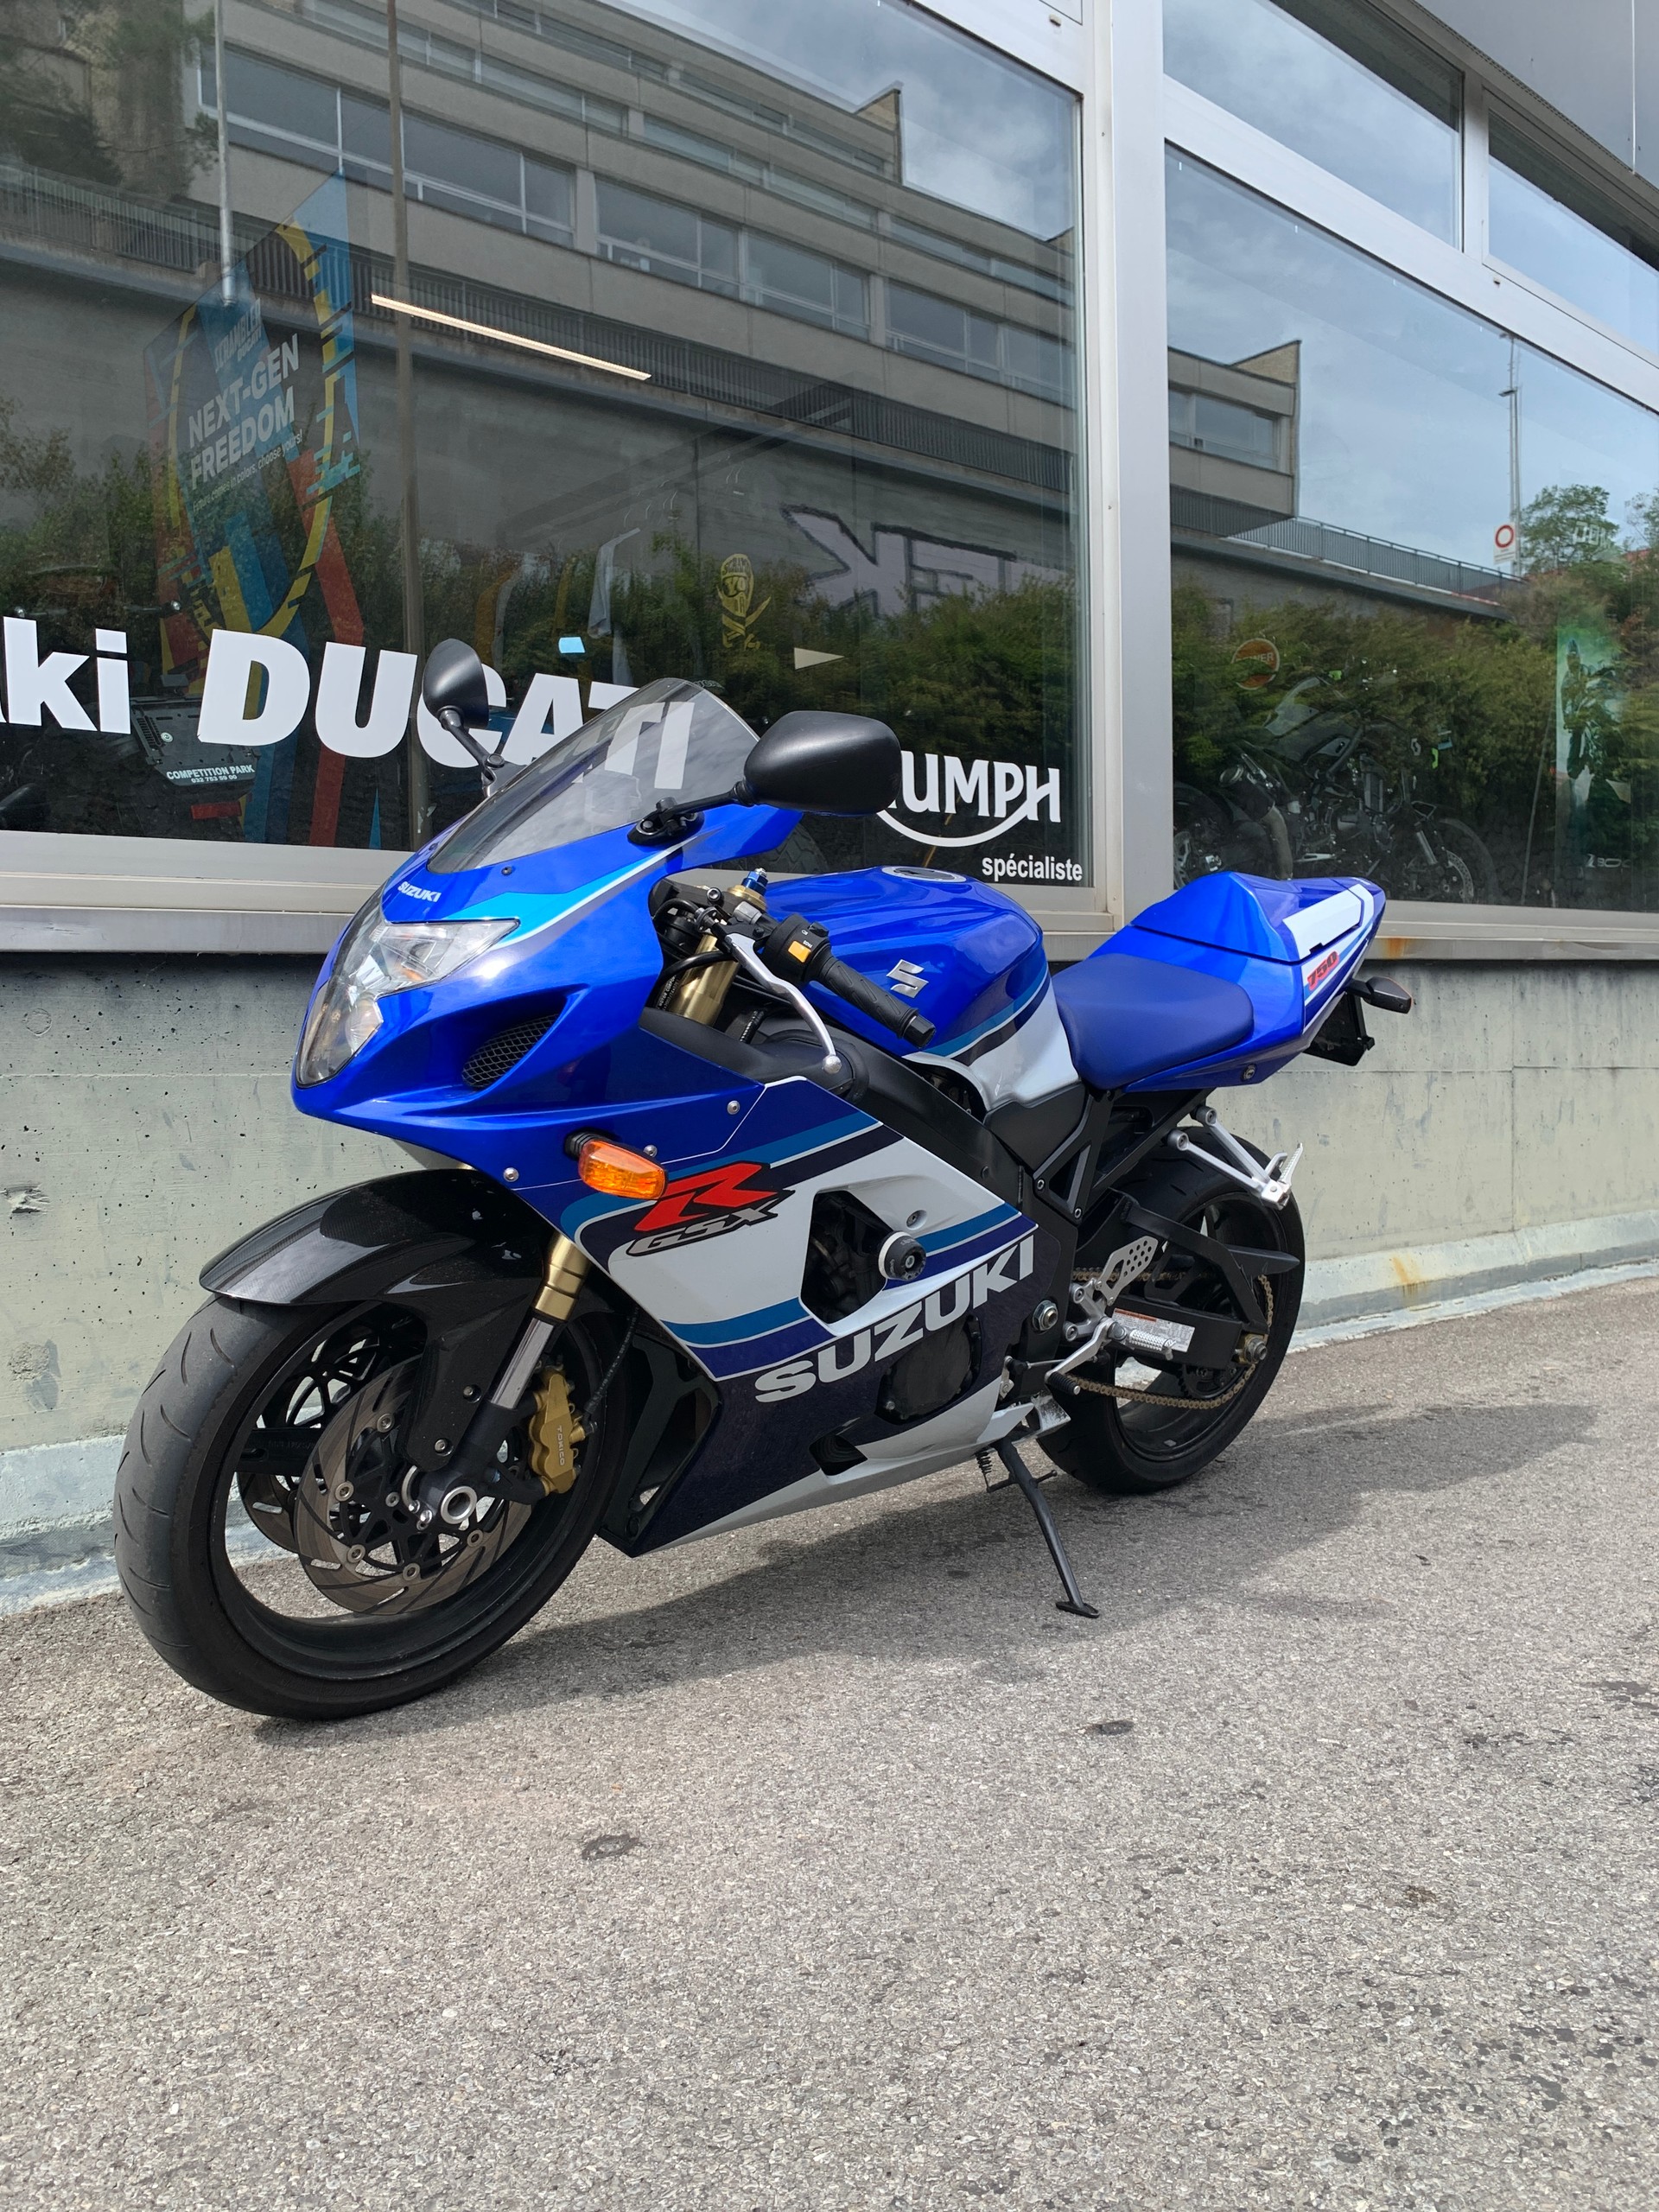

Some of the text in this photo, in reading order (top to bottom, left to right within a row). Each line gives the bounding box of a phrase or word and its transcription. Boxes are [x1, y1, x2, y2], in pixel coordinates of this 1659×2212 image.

[188, 333, 299, 448] NEXT-GEN
[190, 385, 295, 491] FREEDOM
[257, 446, 282, 469] choose
[282, 429, 302, 457] yours!
[0, 616, 131, 734] ki
[166, 765, 256, 780] COMPETITION PARK
[887, 750, 1061, 823] UMPH
[397, 880, 442, 902] SUZUKI
[982, 853, 1083, 881] spécialiste
[1306, 950, 1339, 991] 750
[627, 1198, 779, 1255] GSX
[754, 1234, 1034, 1402] SUZUKI
[556, 1425, 565, 1466] TOKICO
